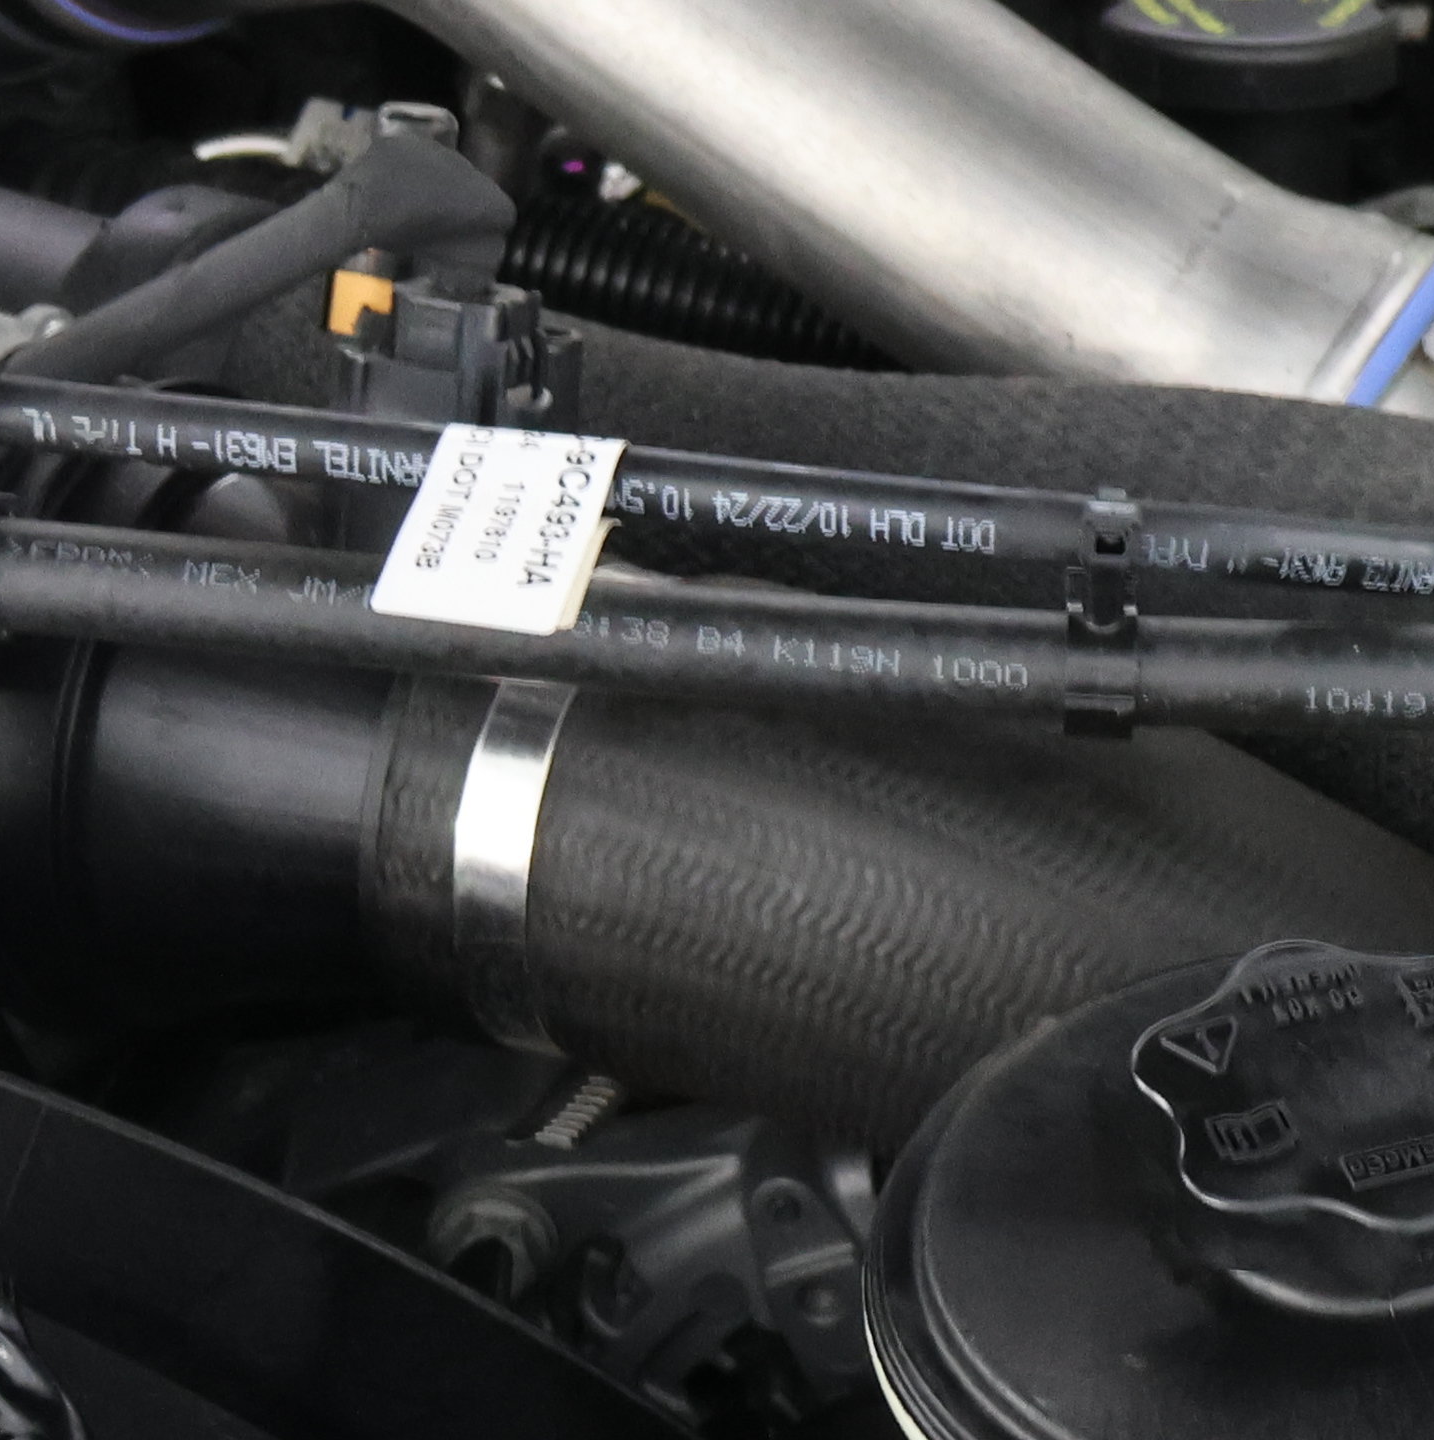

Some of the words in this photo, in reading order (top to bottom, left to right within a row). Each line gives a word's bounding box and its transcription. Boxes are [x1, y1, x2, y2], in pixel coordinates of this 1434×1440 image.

[446, 450, 485, 501] DOT
[710, 489, 852, 539] 10/22/24
[868, 507, 926, 548] DLH
[939, 515, 997, 556] DOT
[931, 655, 1030, 691] 1000
